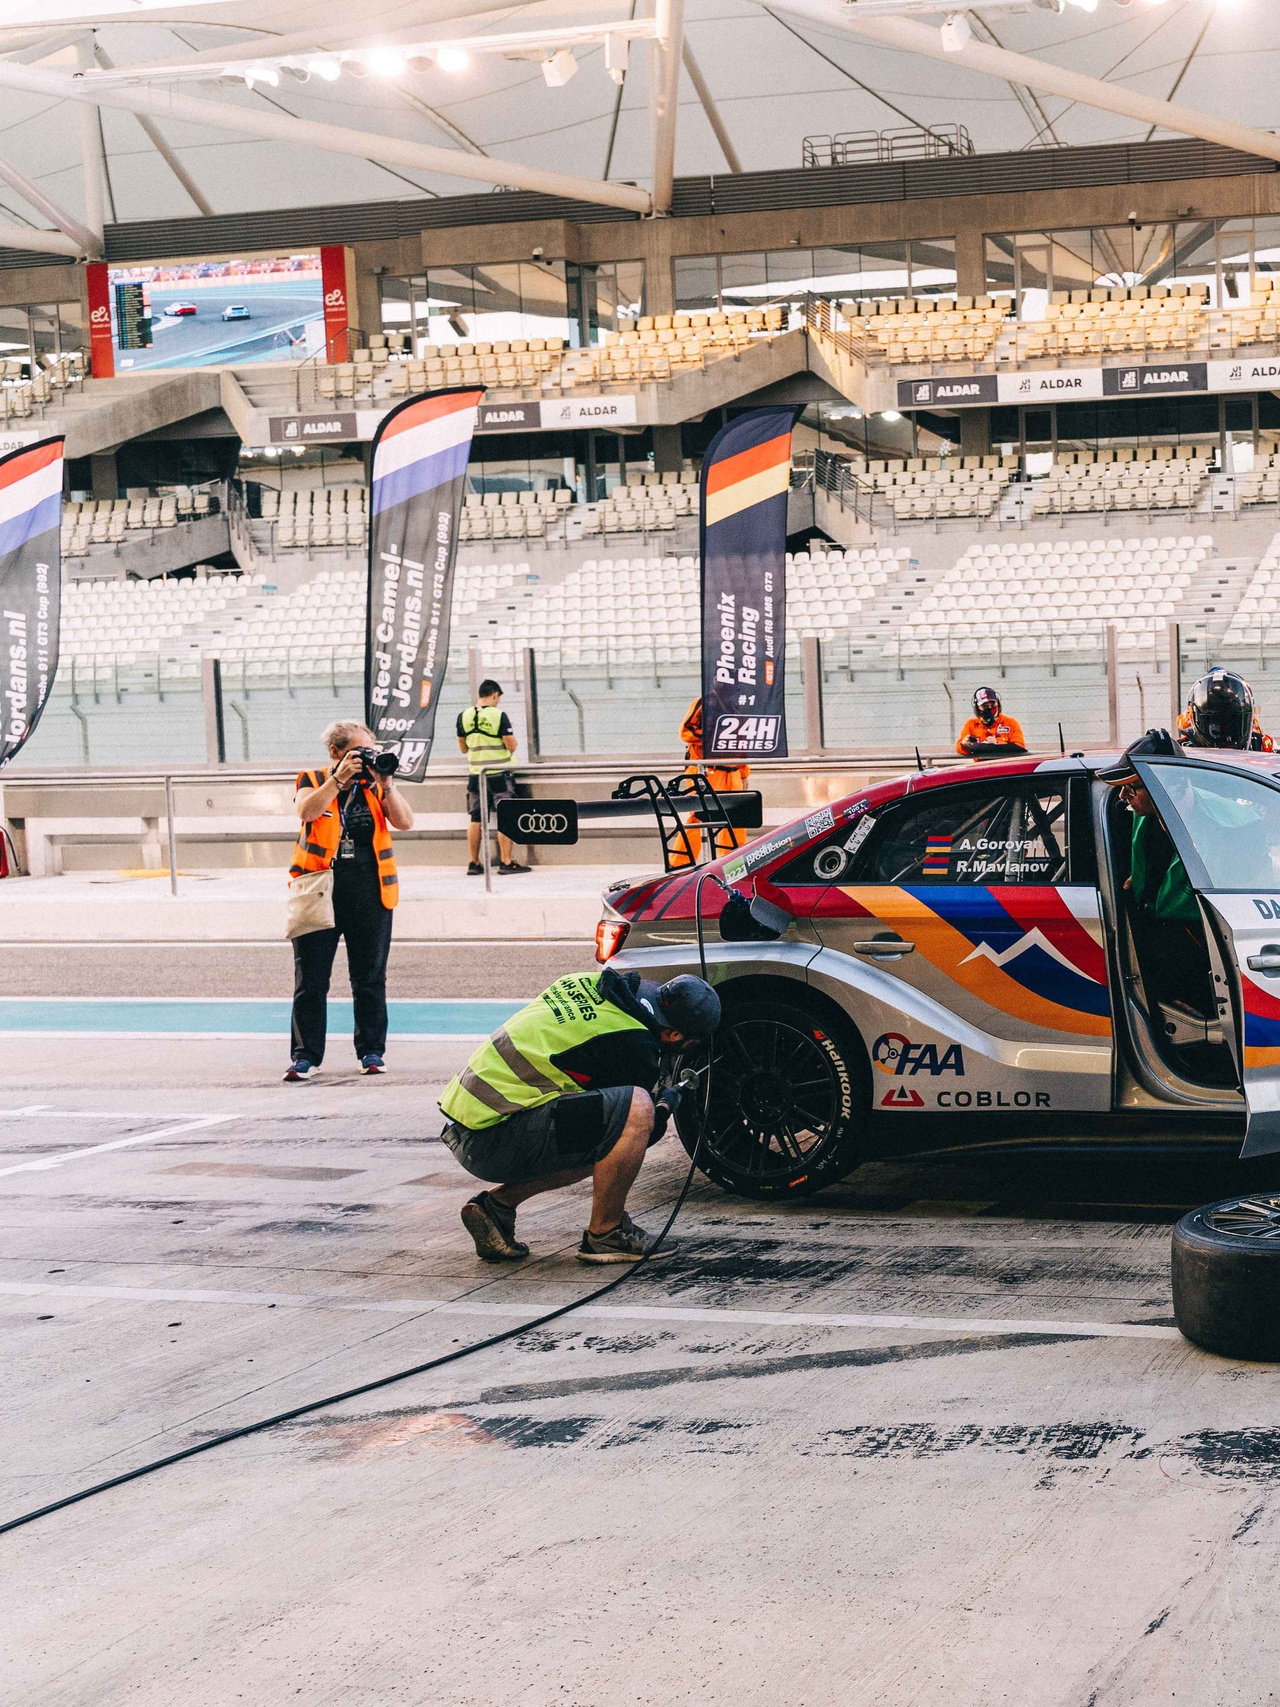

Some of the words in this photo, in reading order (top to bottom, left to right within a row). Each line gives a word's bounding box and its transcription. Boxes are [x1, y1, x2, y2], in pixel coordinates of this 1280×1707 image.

[1040, 378, 1082, 389] ALDAR
[1143, 370, 1189, 385] ALDAR
[936, 383, 980, 397] ALDAR
[484, 411, 525, 423] ALDAR
[579, 405, 617, 416] ALDAR
[303, 421, 342, 434] ALDAR
[436, 511, 451, 544] (992)
[434, 546, 448, 571] Cup
[36, 562, 49, 594] (992)
[433, 574, 444, 599] GT3
[764, 571, 773, 592] GT3
[376, 543, 401, 643] Camel-
[37, 596, 49, 619] Cup
[431, 602, 441, 625] 911
[764, 596, 773, 618] LMS
[37, 621, 48, 646] GT3
[392, 558, 424, 708] Jordans.nl
[765, 618, 773, 634] R8
[717, 592, 735, 685] Phoenix
[738, 606, 759, 686] Racing
[765, 637, 774, 658] Audi
[423, 628, 438, 677] Porsche
[372, 651, 392, 707] Red
[738, 694, 755, 706] #1
[718, 718, 777, 740] 24H
[717, 739, 774, 750] SERIES
[748, 836, 792, 866] production
[960, 838, 1043, 852] A.Goroyan
[956, 860, 1049, 873] R.Mavlanov
[560, 978, 577, 991] 4H
[894, 1043, 965, 1076] FAA
[937, 1091, 1051, 1107] COBLOR
